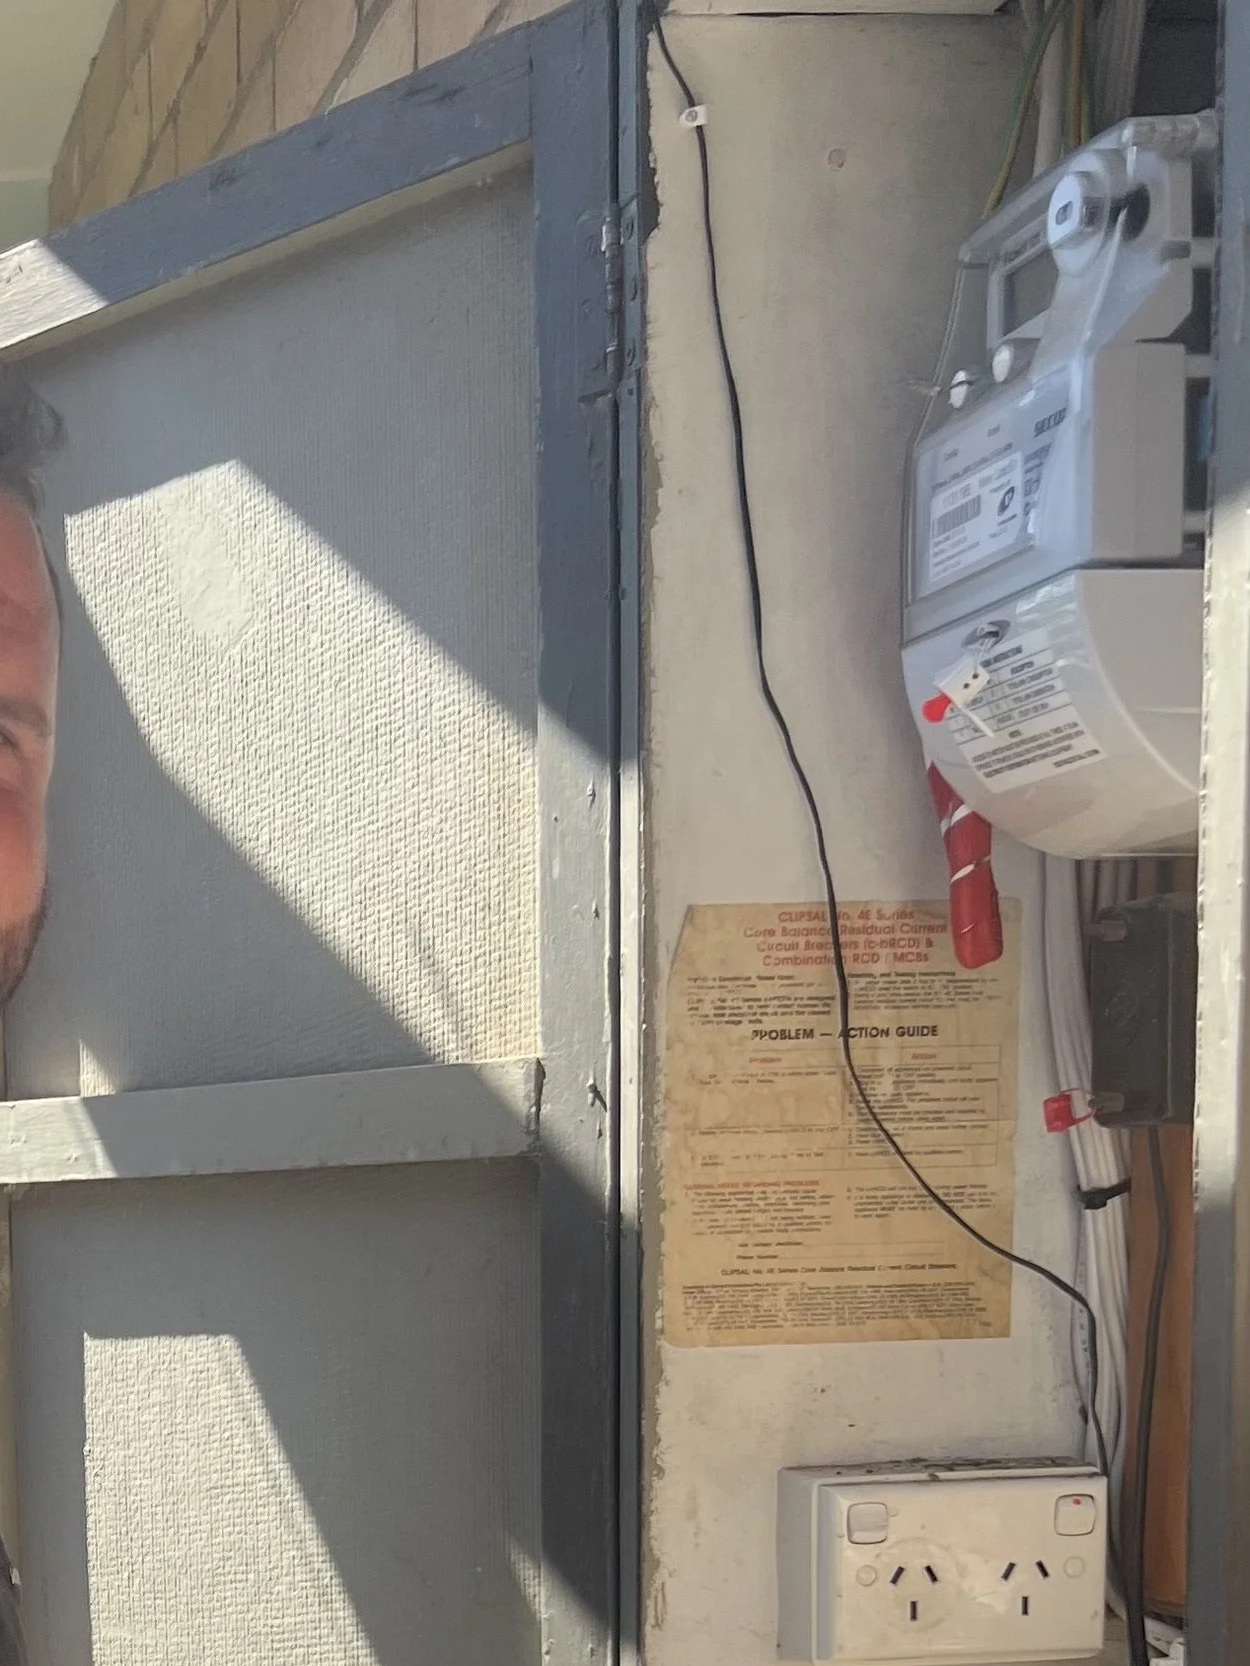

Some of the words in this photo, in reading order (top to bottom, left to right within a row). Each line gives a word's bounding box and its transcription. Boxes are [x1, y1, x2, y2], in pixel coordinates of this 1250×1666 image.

[778, 911, 827, 922] CLIPSAL
[743, 926, 776, 938] Core
[840, 923, 895, 936] Residual
[852, 953, 880, 965] RCD
[895, 1025, 939, 1038] GUIDE
